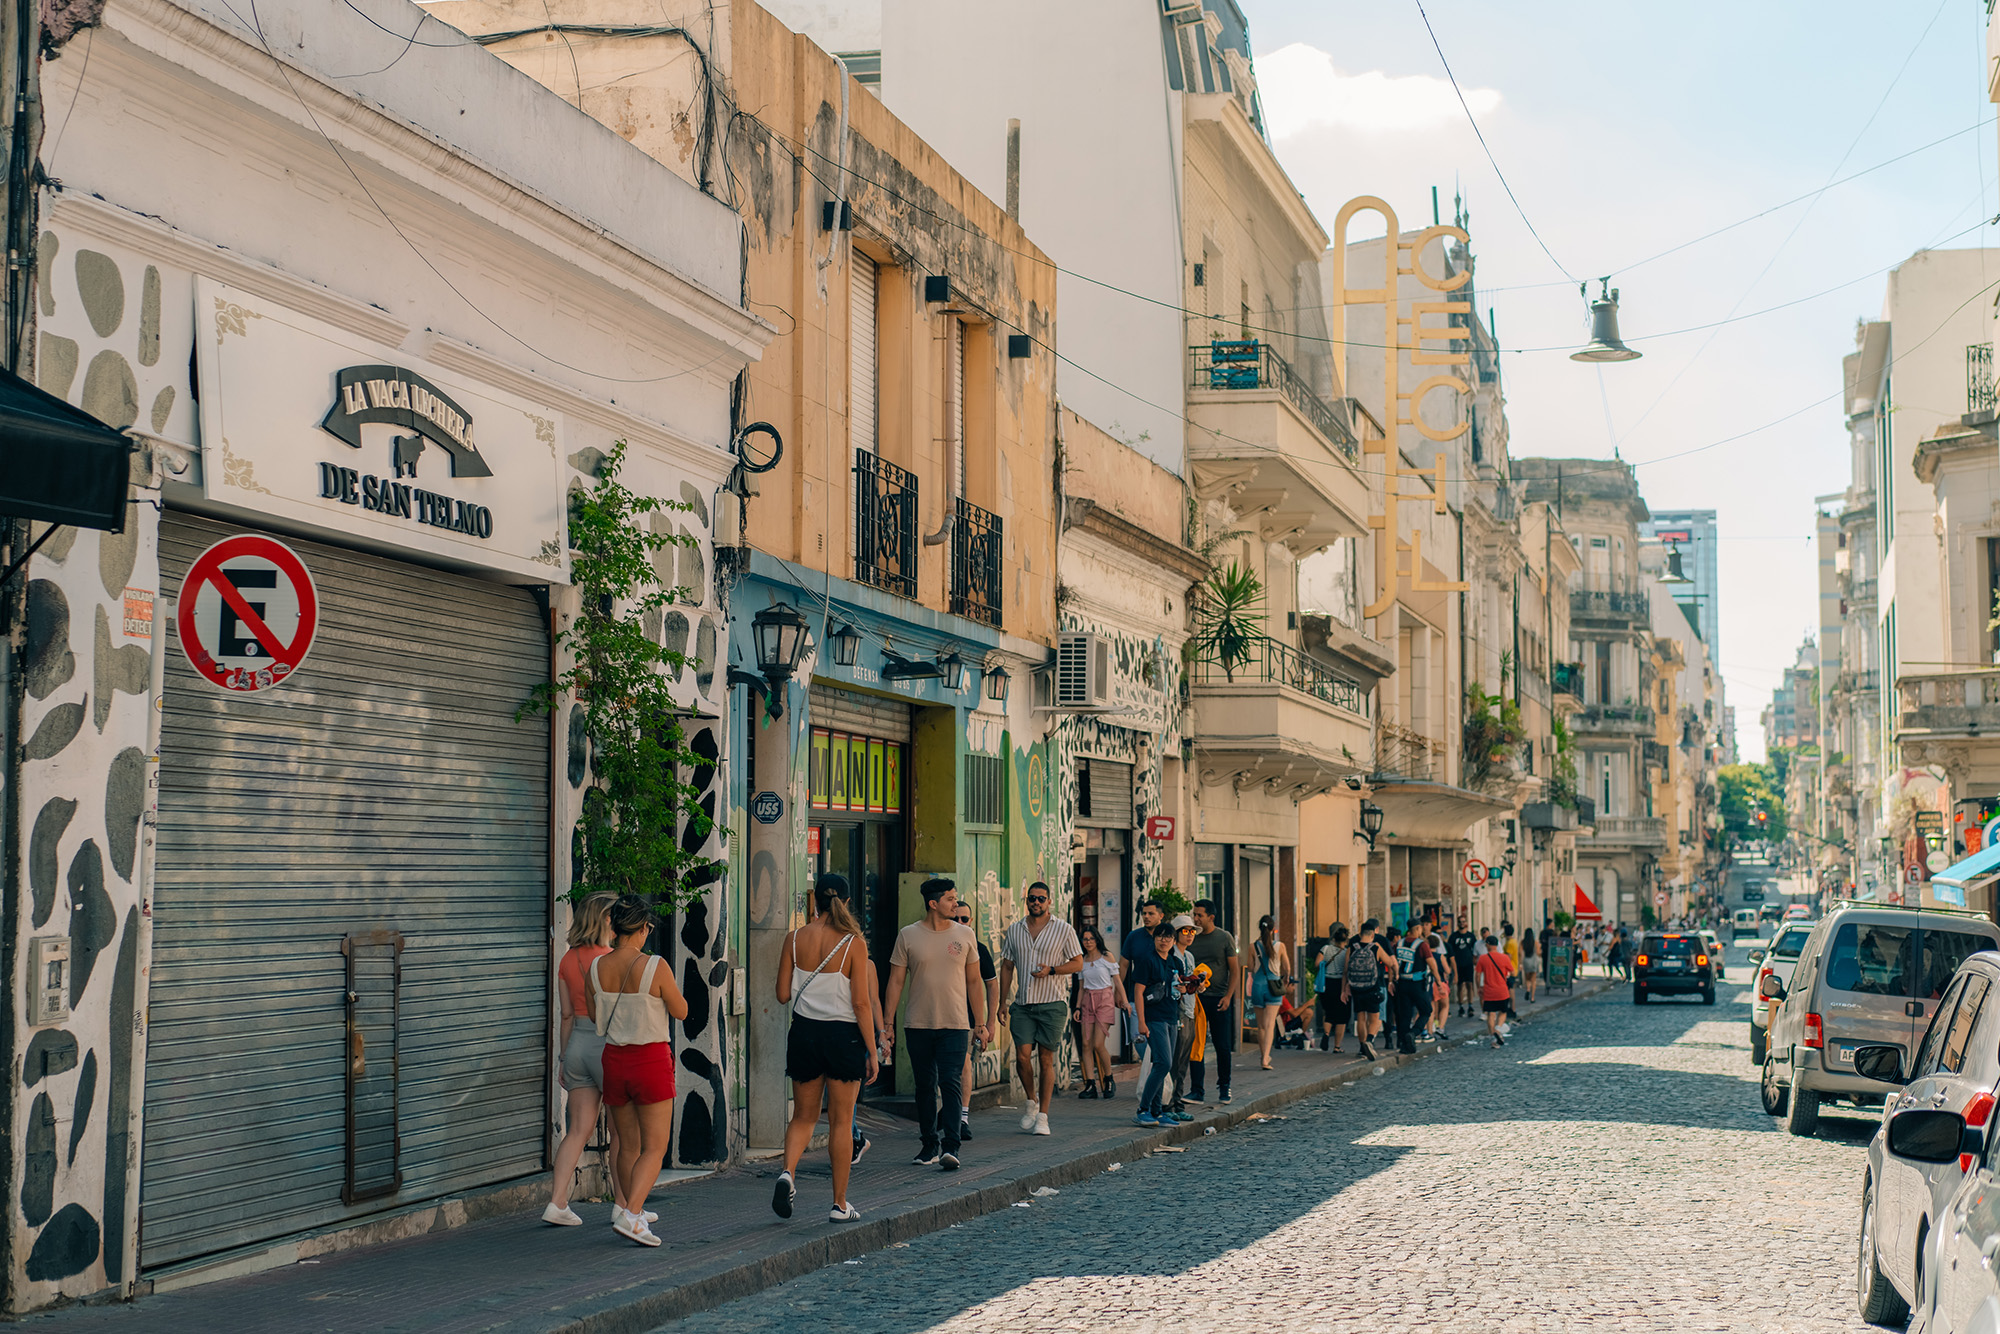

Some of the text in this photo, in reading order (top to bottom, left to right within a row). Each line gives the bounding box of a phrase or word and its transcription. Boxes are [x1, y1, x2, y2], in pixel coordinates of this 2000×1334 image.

[342, 378, 475, 452] LA VACA LECHERA
[320, 461, 494, 539] DE SAN TELMO
[853, 665, 879, 684] DEFENSA
[757, 802, 779, 815] USS
